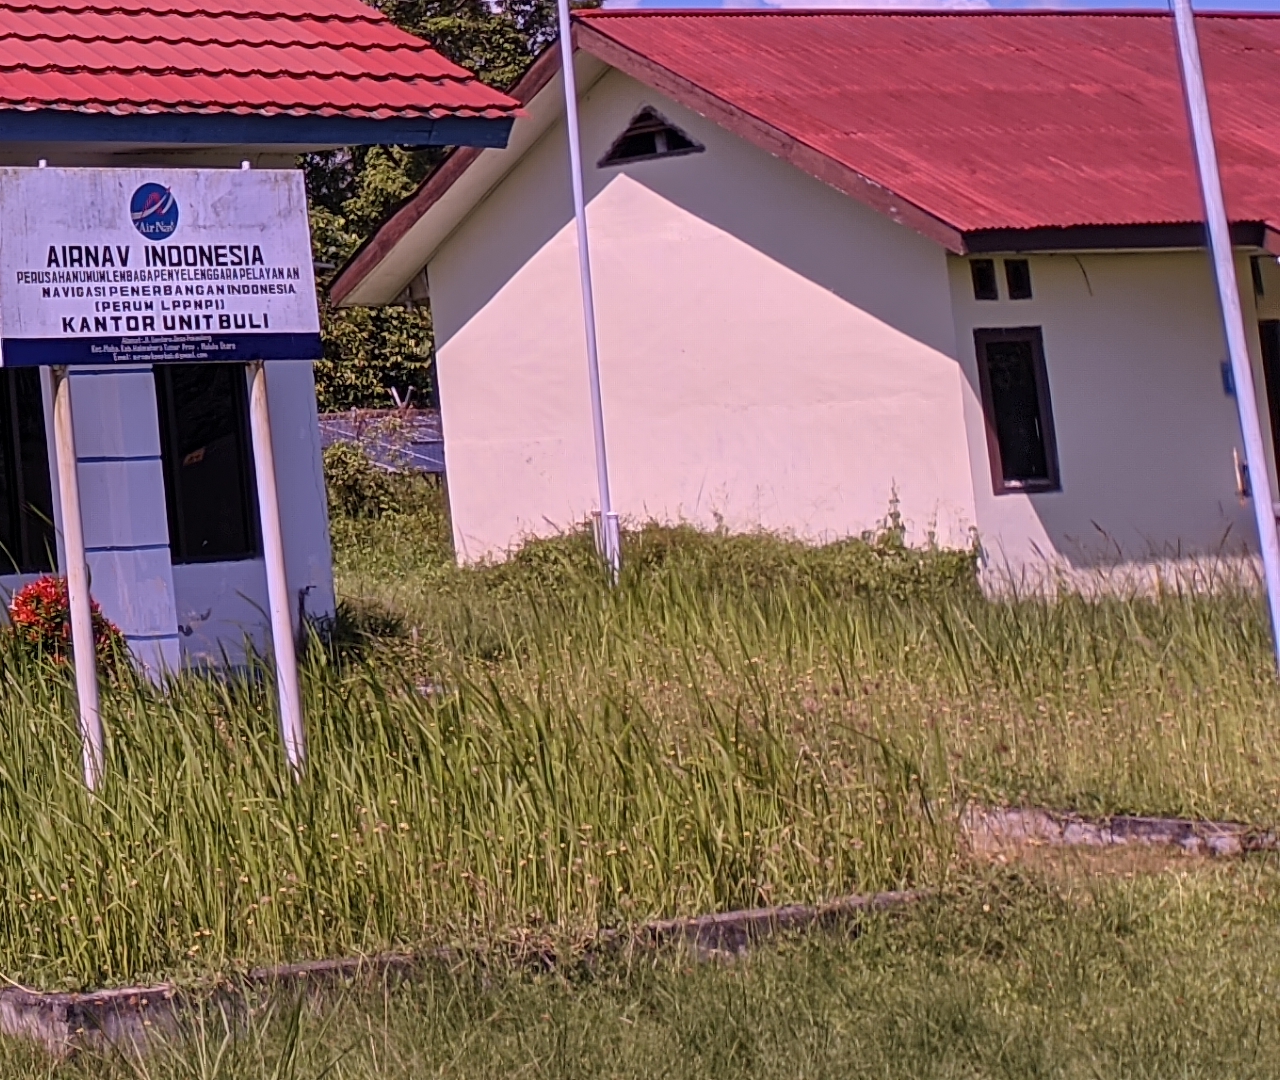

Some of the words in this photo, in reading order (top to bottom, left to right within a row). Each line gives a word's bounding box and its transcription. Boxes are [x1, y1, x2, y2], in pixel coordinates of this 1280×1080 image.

[47, 245, 130, 268] AIRNAV
[143, 244, 265, 267] INDONESIA
[42, 286, 106, 298] NAVIGASI
[109, 284, 225, 297] PENERBANGAN
[227, 283, 297, 295] INDONESIA
[95, 300, 154, 312] (PERUM
[160, 299, 225, 311] LPPNPI)
[62, 315, 156, 333] KANTOR
[162, 314, 214, 331] UNIT
[218, 312, 269, 330] BULI
